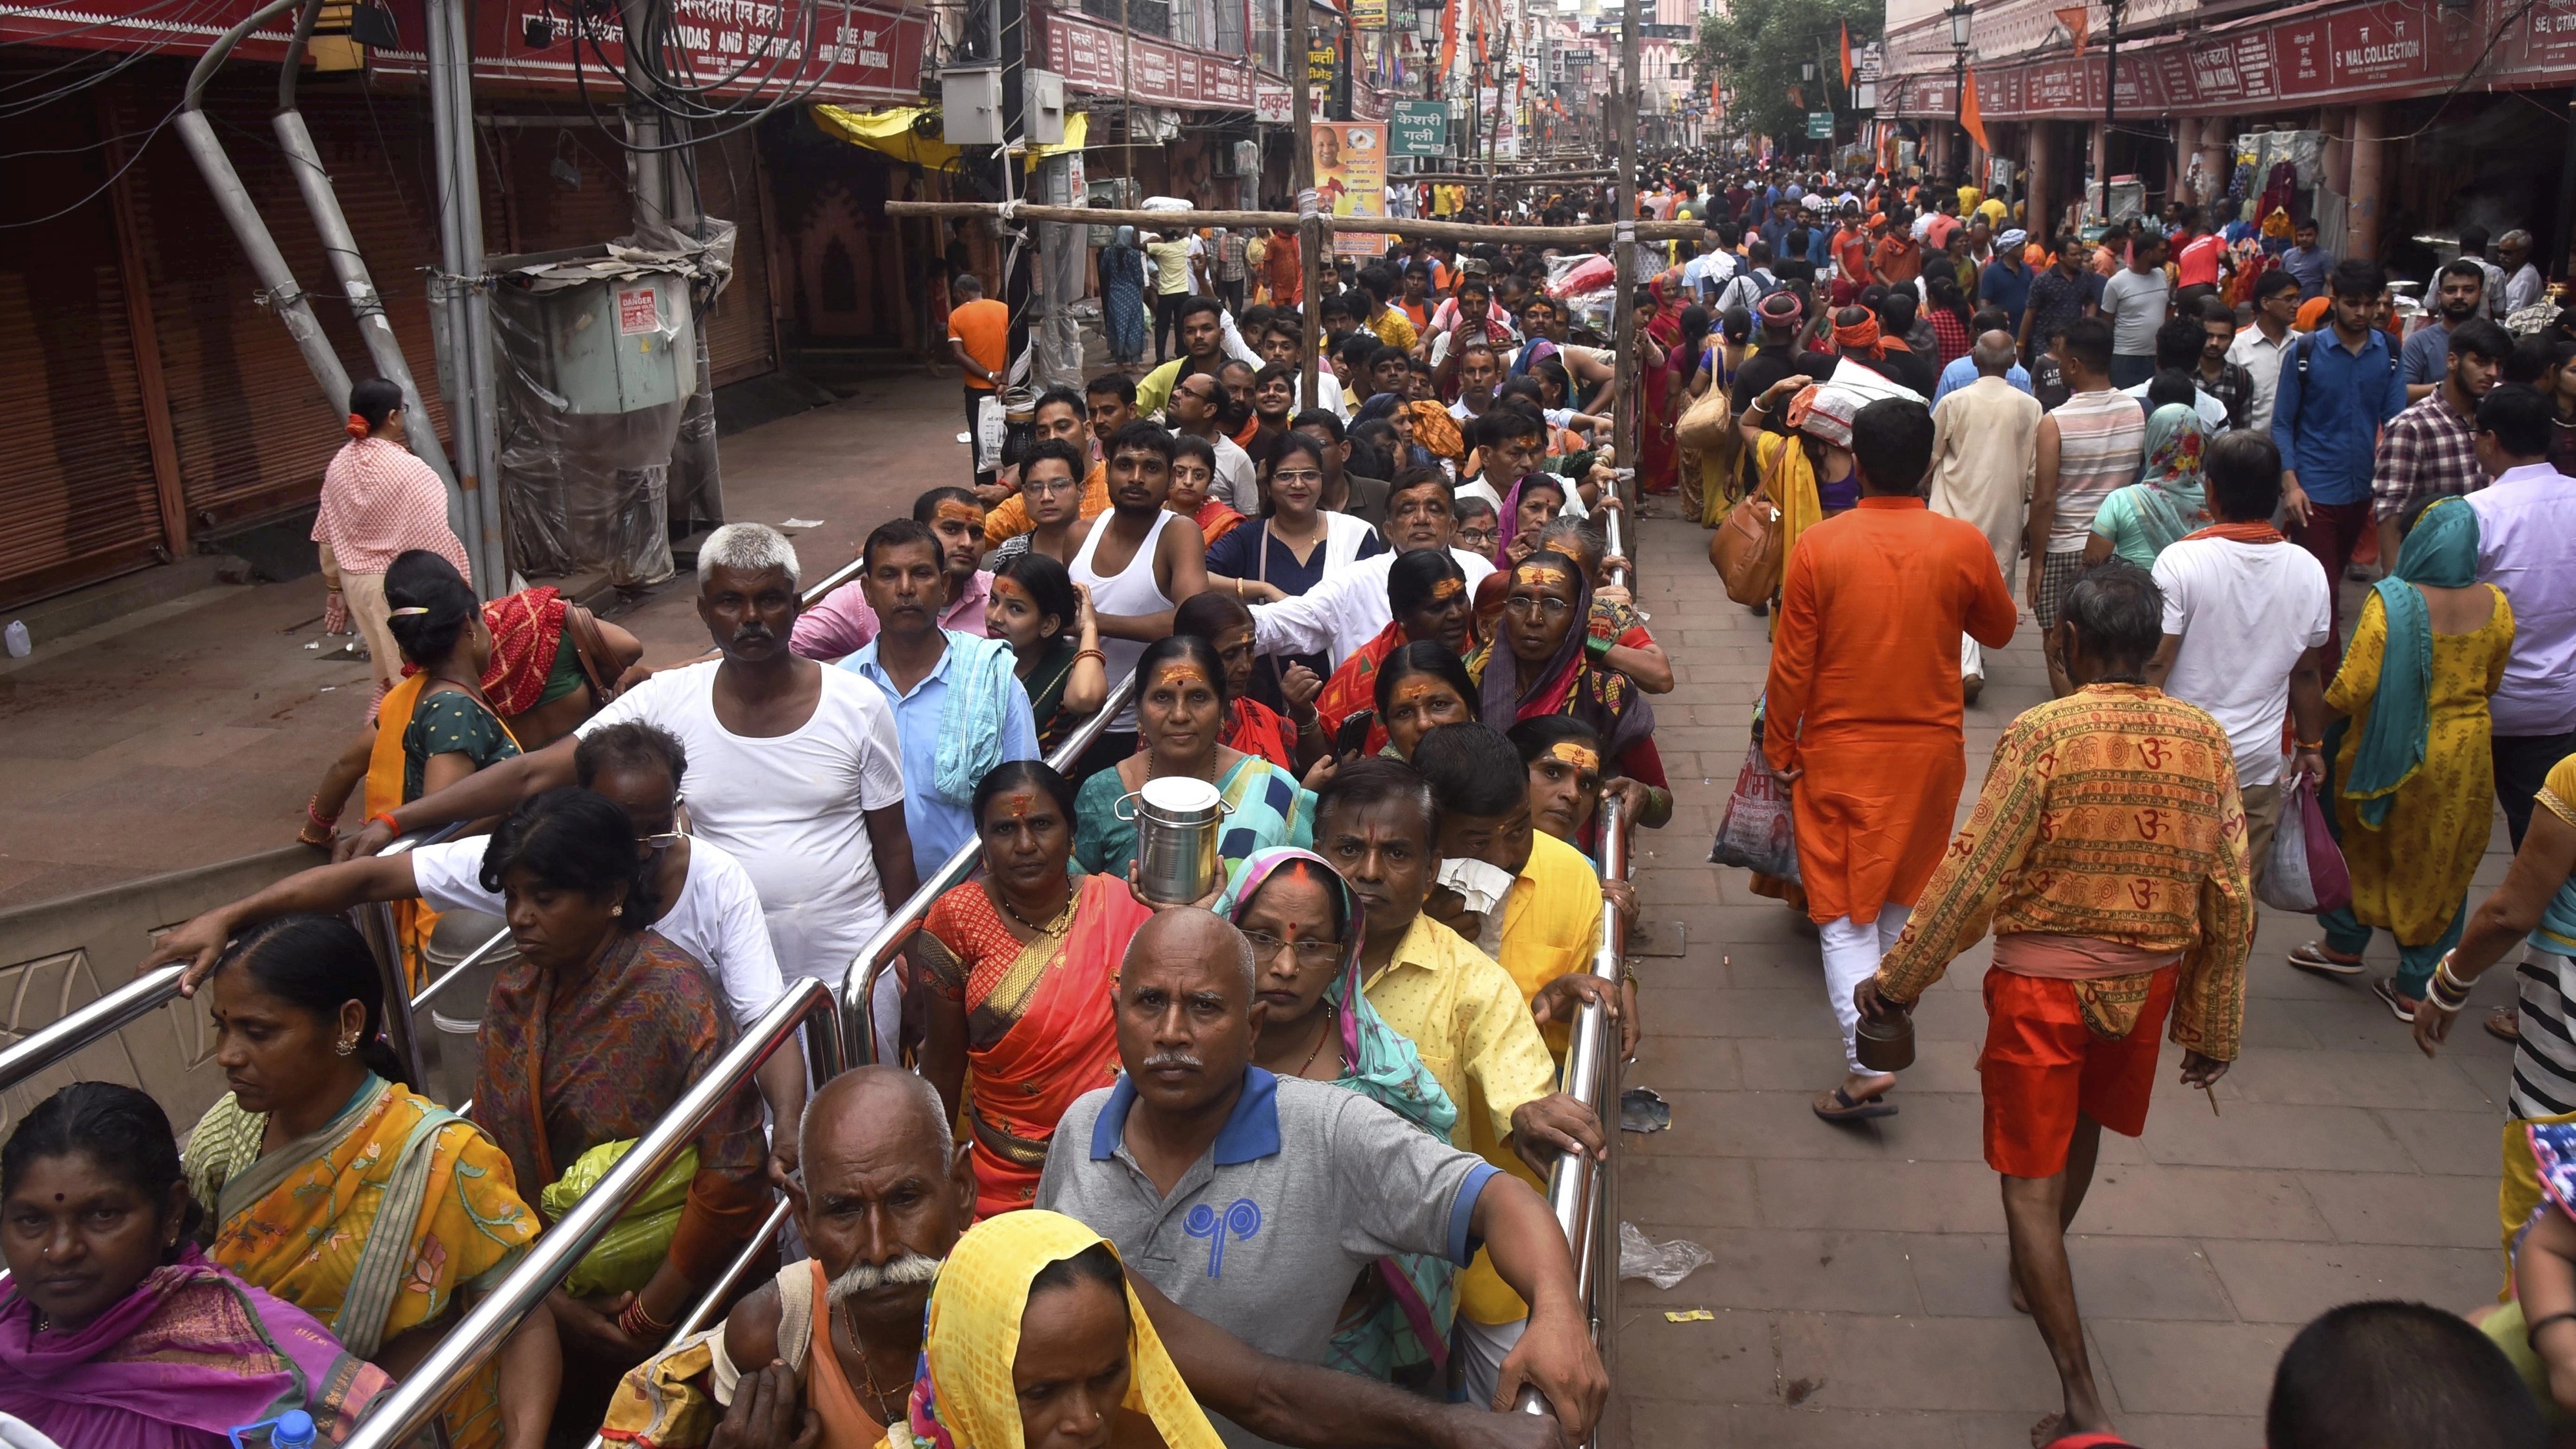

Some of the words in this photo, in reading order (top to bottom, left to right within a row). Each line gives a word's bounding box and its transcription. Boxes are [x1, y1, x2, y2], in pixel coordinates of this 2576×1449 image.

[718, 32, 743, 54] AND
[2365, 39, 2420, 64] COLLECTION
[819, 43, 833, 62] AND
[859, 49, 889, 69] MATERIAL
[1259, 93, 1292, 119] ठाकुर
[1397, 112, 1442, 126] केशरी
[1403, 129, 1434, 141] गली
[622, 297, 652, 307] DANGER
